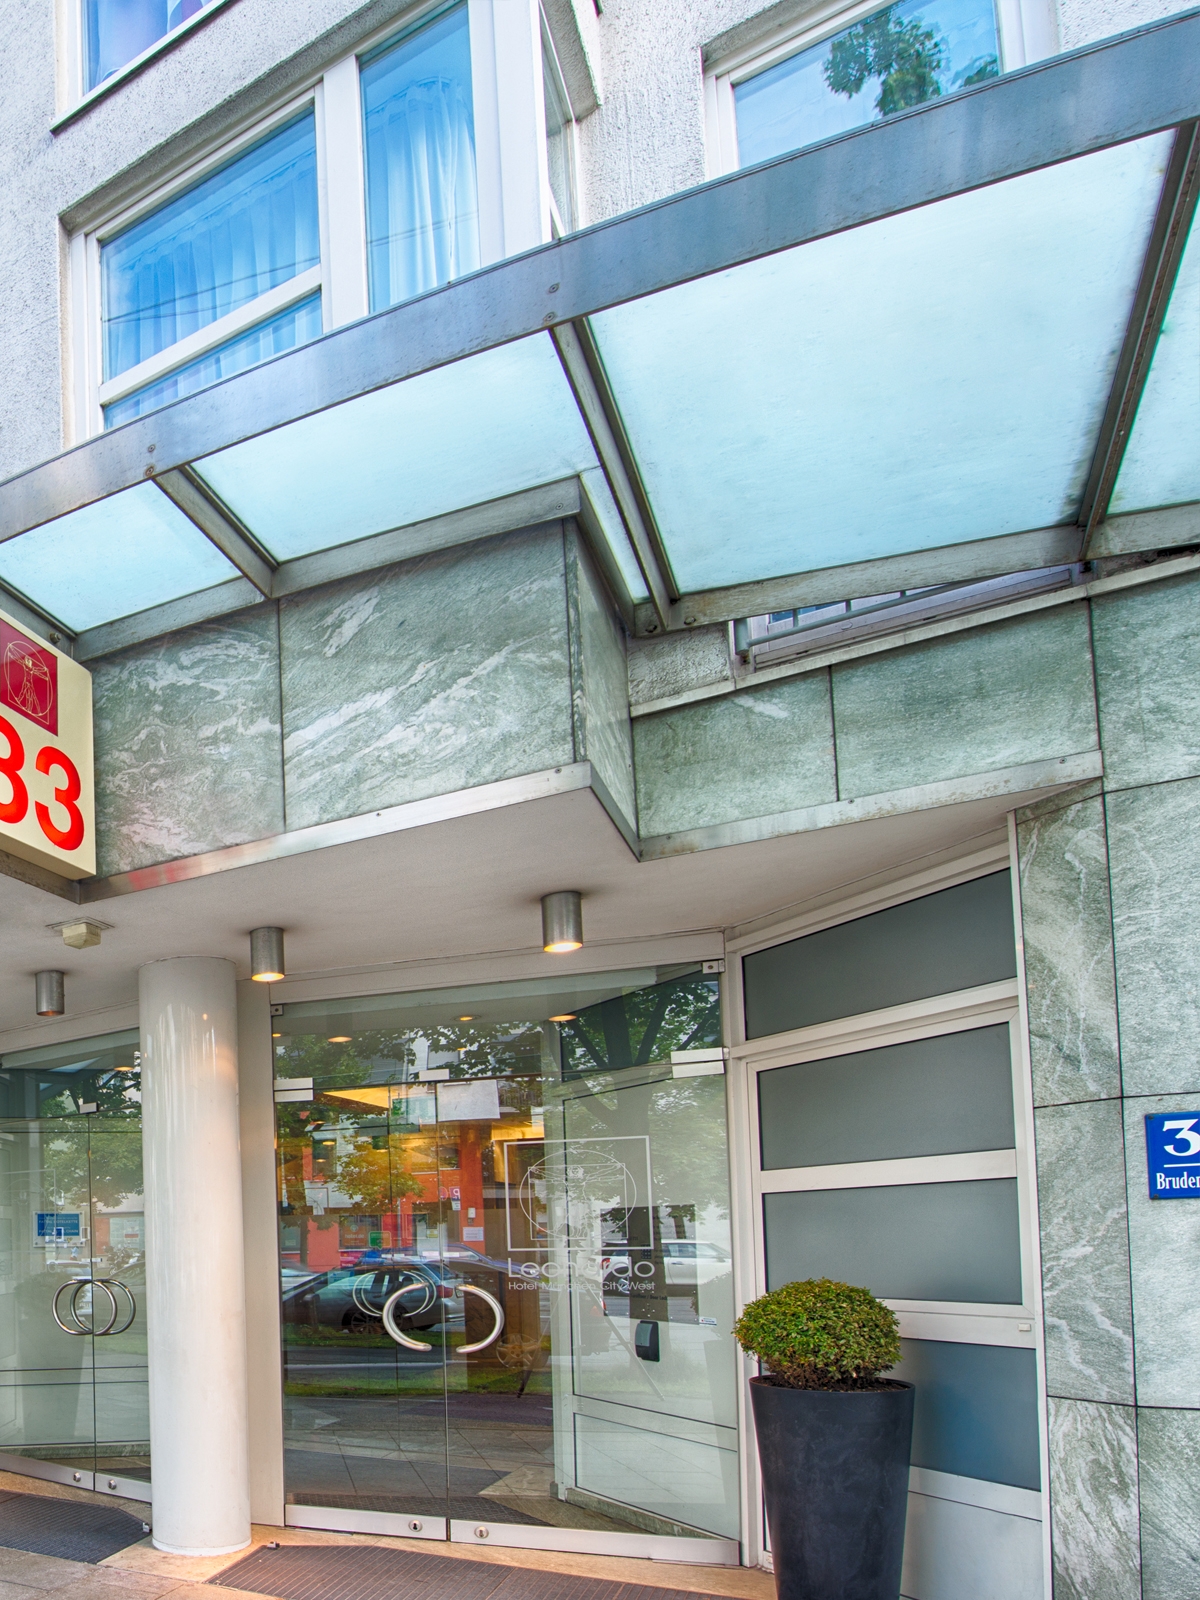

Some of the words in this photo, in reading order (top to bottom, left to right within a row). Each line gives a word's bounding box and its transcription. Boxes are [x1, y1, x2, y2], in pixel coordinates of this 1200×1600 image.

[1162, 1119, 1200, 1157] 3
[508, 1257, 656, 1278] Leonardo
[508, 1281, 538, 1291] Hotel
